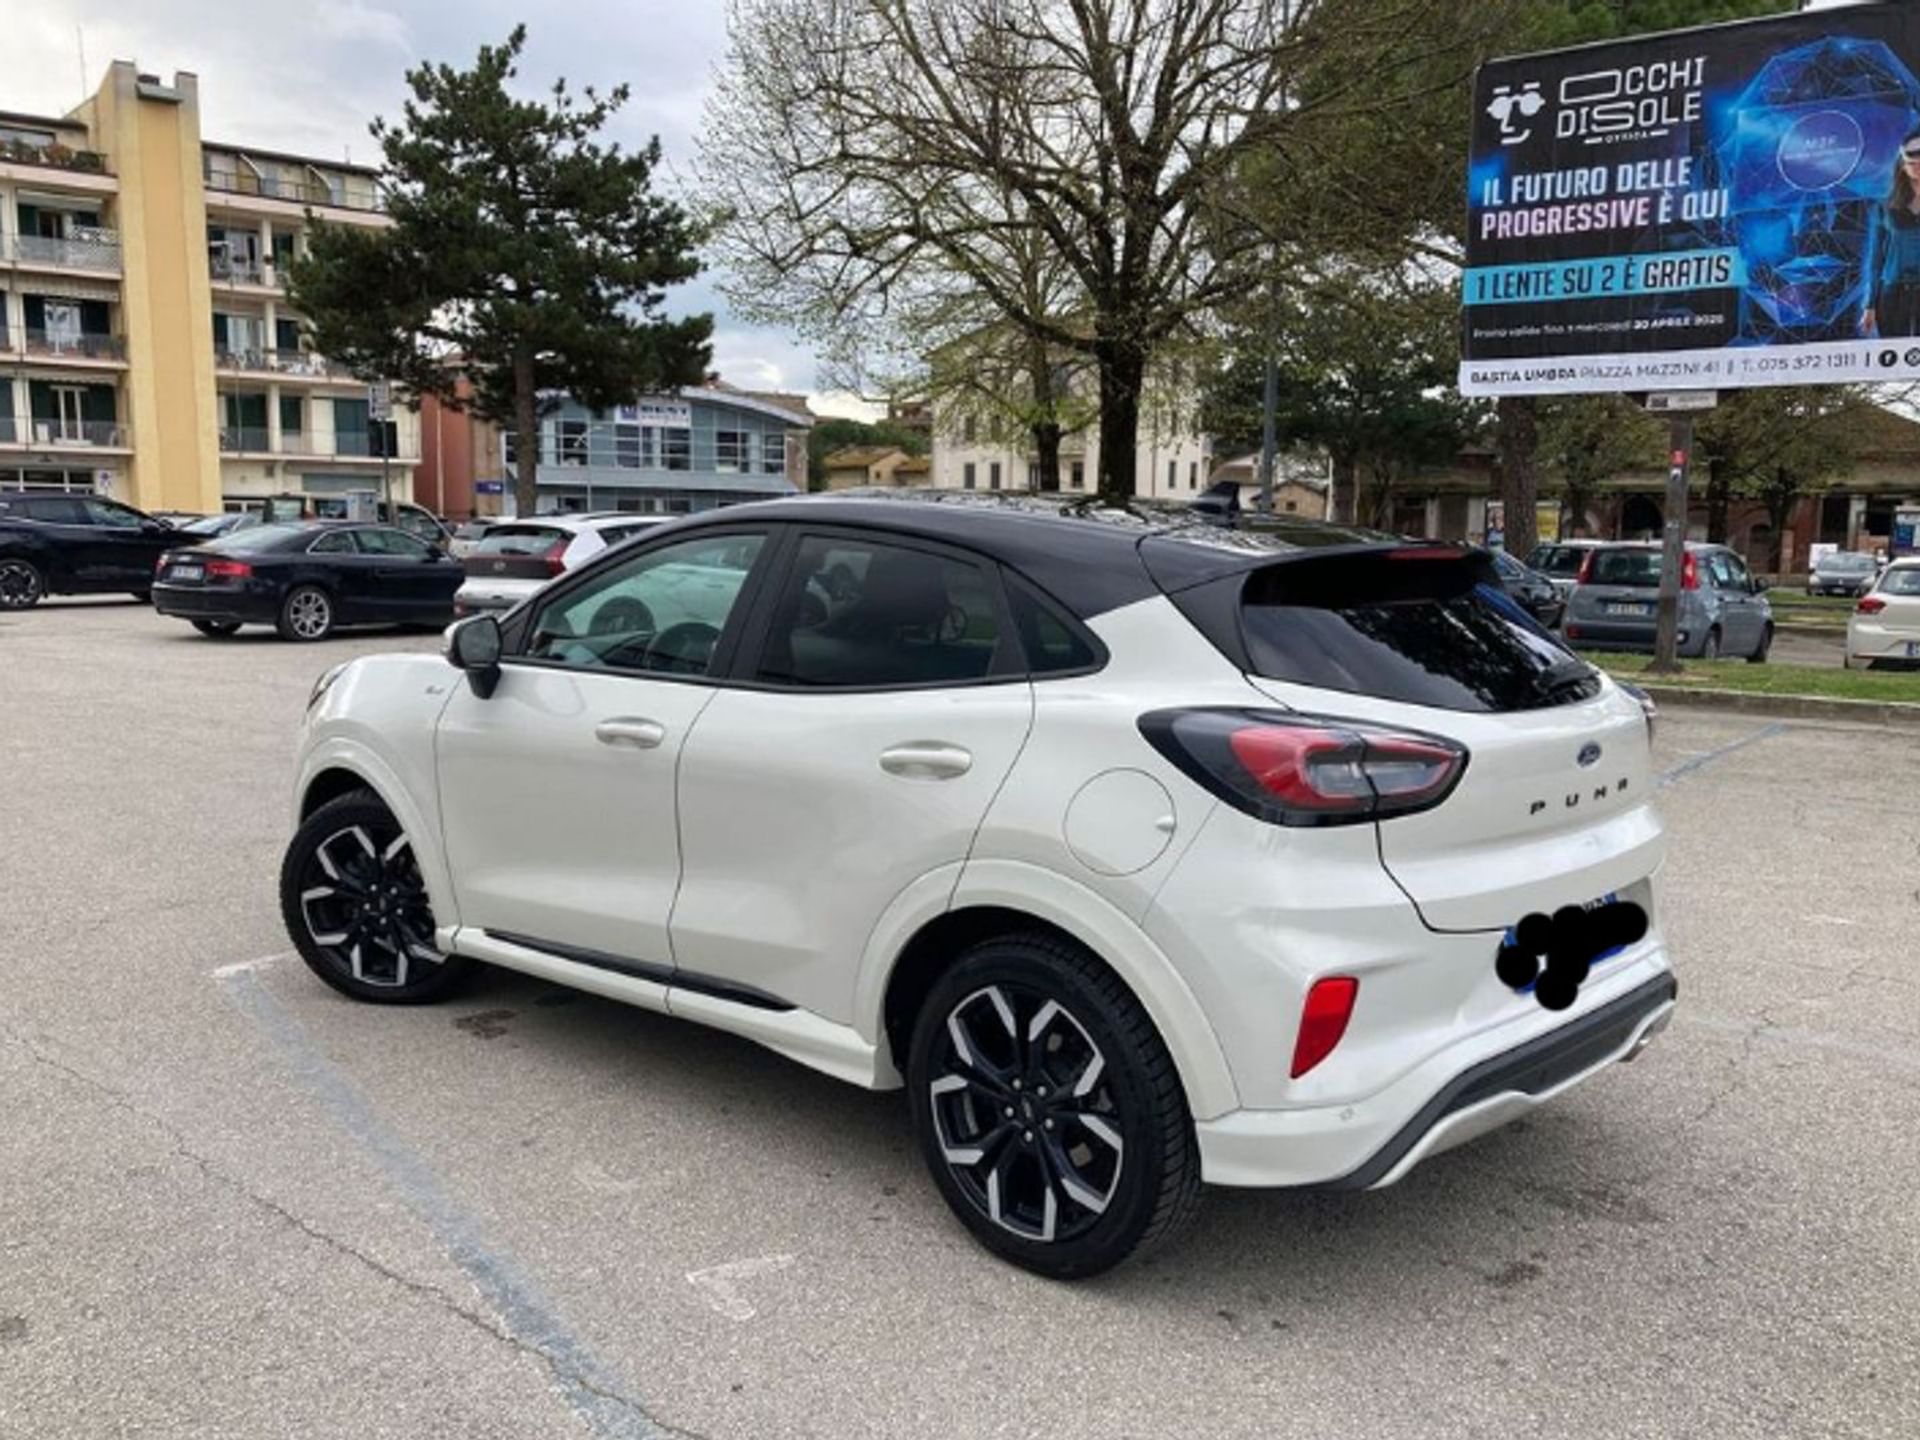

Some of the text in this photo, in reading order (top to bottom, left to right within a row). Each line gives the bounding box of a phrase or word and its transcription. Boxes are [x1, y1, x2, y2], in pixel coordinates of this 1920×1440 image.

[1560, 56, 1706, 104] OCCHI
[1483, 156, 1693, 206] IL FUTURO DELLE
[1481, 189, 1729, 240] PROGRESSIVE È QUI
[1477, 254, 1732, 300] 1 LENTE SU 2 È GRATIS
[1471, 370, 1521, 383] BASTIA
[1581, 364, 1632, 378] PIAZZA
[1638, 362, 1700, 376] MAZZINI
[1758, 358, 1789, 371] 075
[1792, 355, 1821, 370] 372
